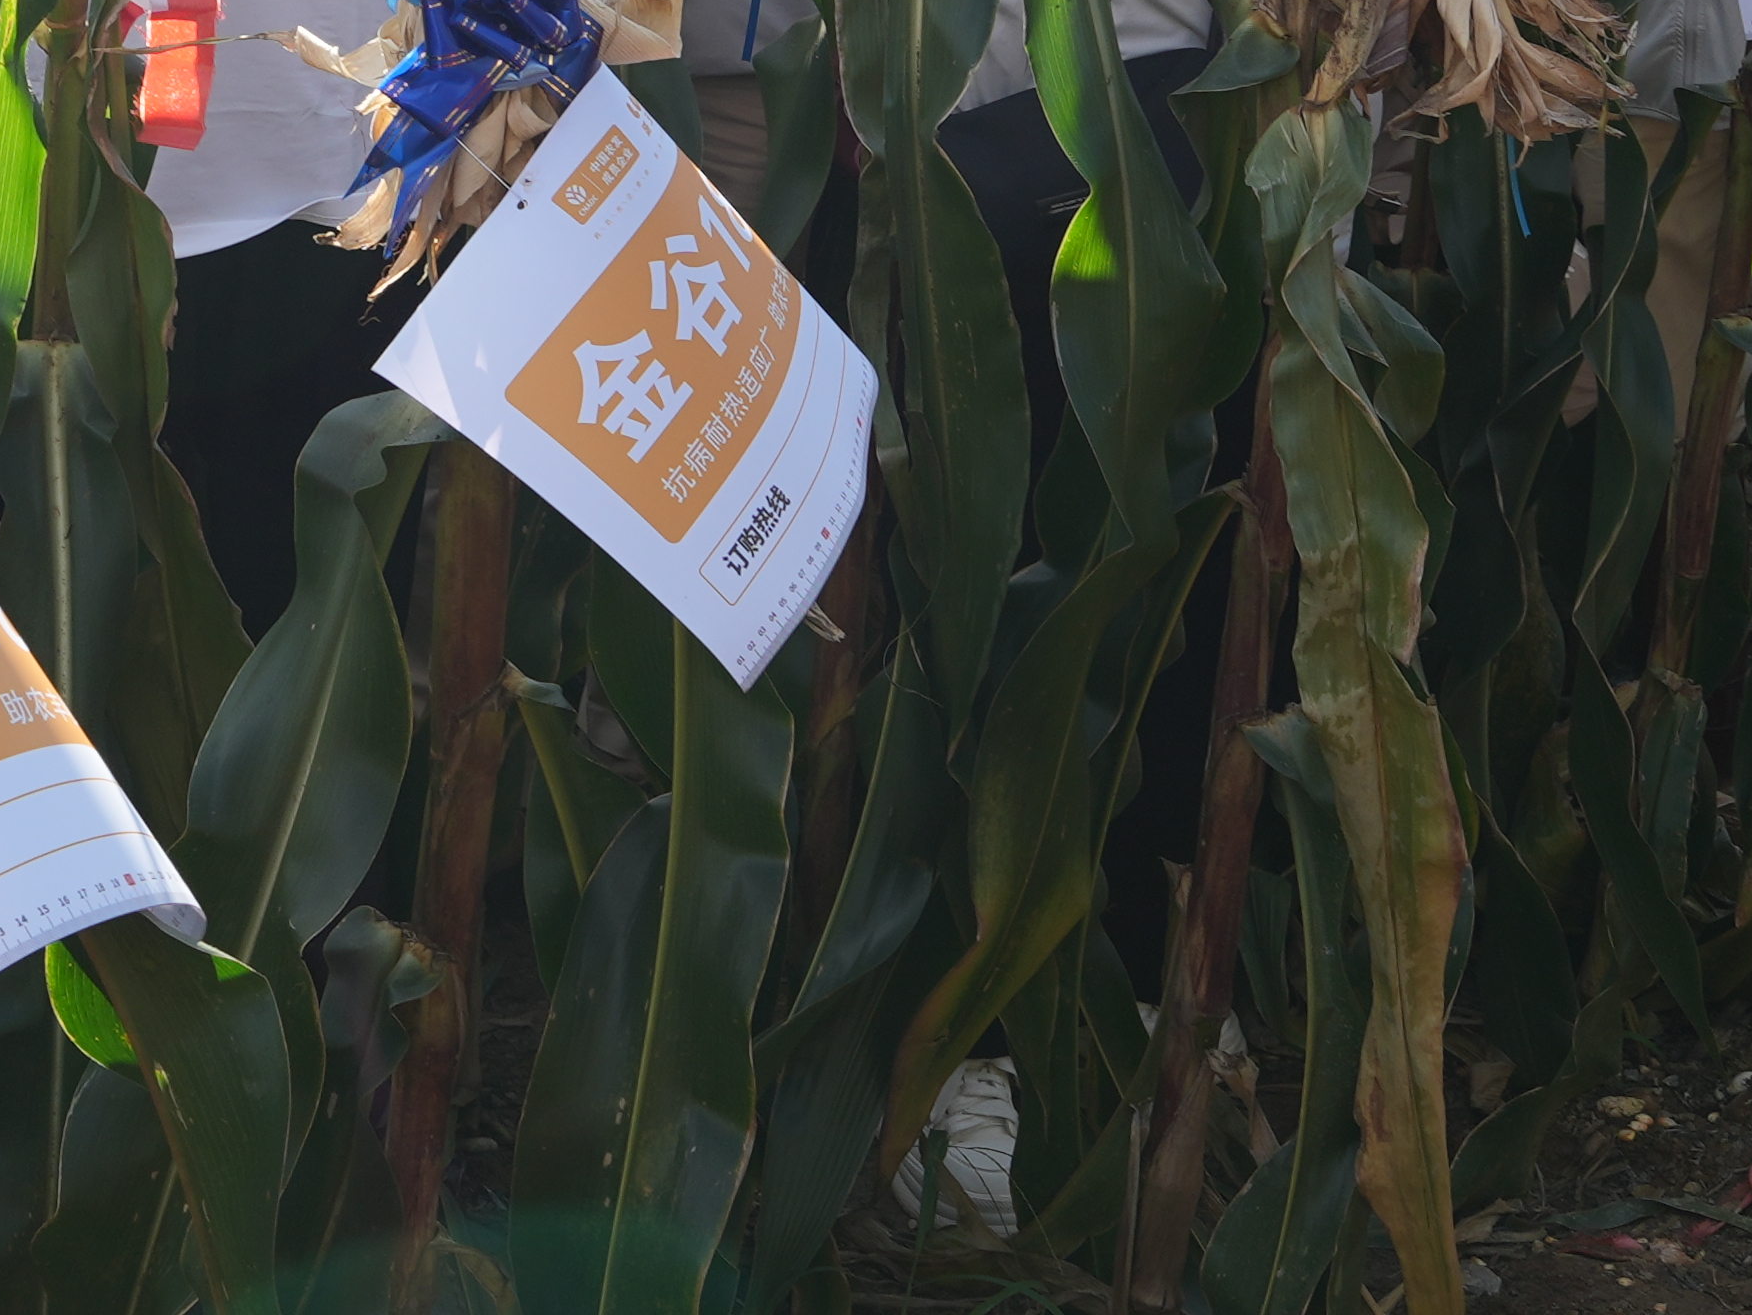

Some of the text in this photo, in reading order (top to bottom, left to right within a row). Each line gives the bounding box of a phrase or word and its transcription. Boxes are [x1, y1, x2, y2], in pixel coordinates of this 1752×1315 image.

[661, 324, 777, 505] 抗病耐热适应广
[722, 484, 793, 576] 订购热线
